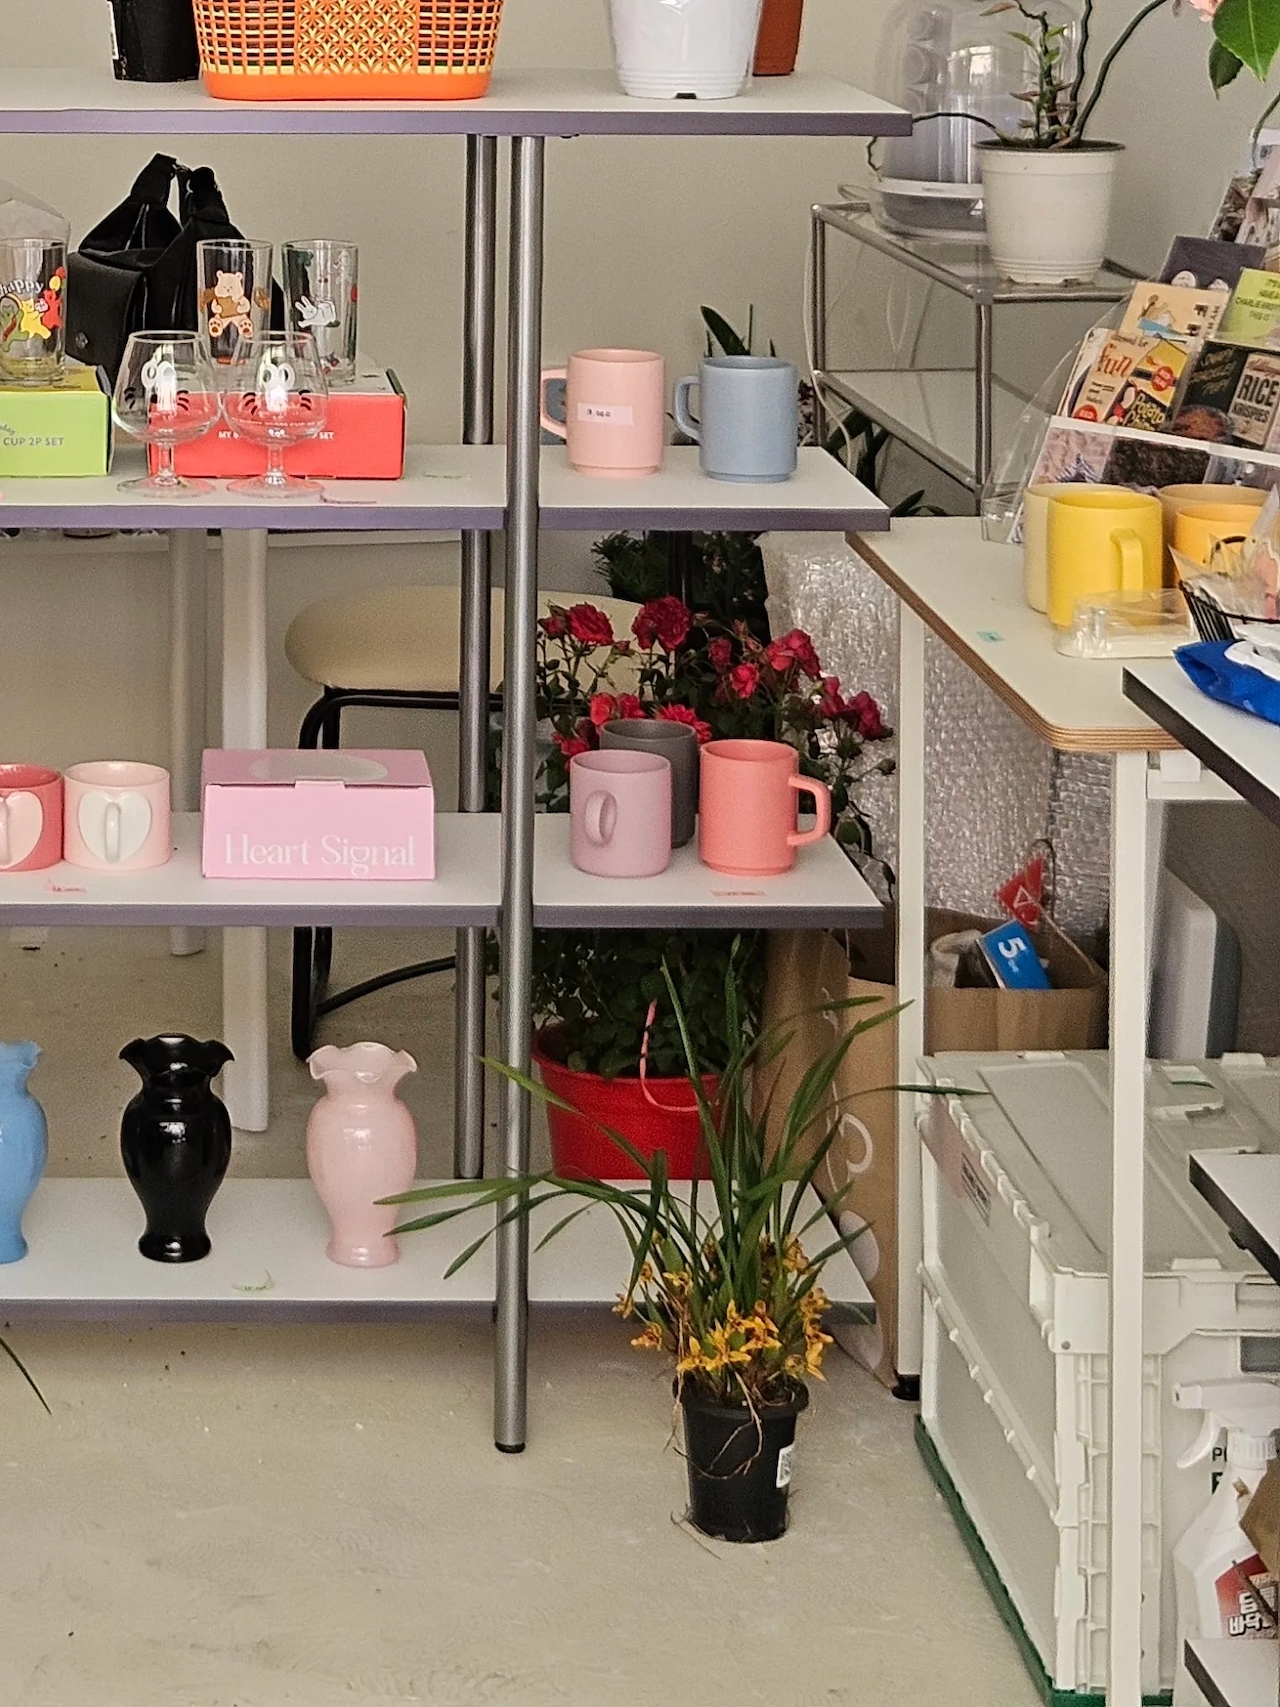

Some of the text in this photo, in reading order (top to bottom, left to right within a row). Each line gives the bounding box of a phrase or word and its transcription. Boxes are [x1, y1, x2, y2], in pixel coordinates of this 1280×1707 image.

[1096, 341, 1132, 377] fun
[1237, 374, 1280, 407] RICE
[3, 437, 26, 446] CUP
[29, 437, 42, 446] 2P
[44, 437, 65, 446] SET
[319, 431, 334, 439] SET
[225, 833, 416, 877] Heart Signal
[997, 937, 1028, 959] 5
